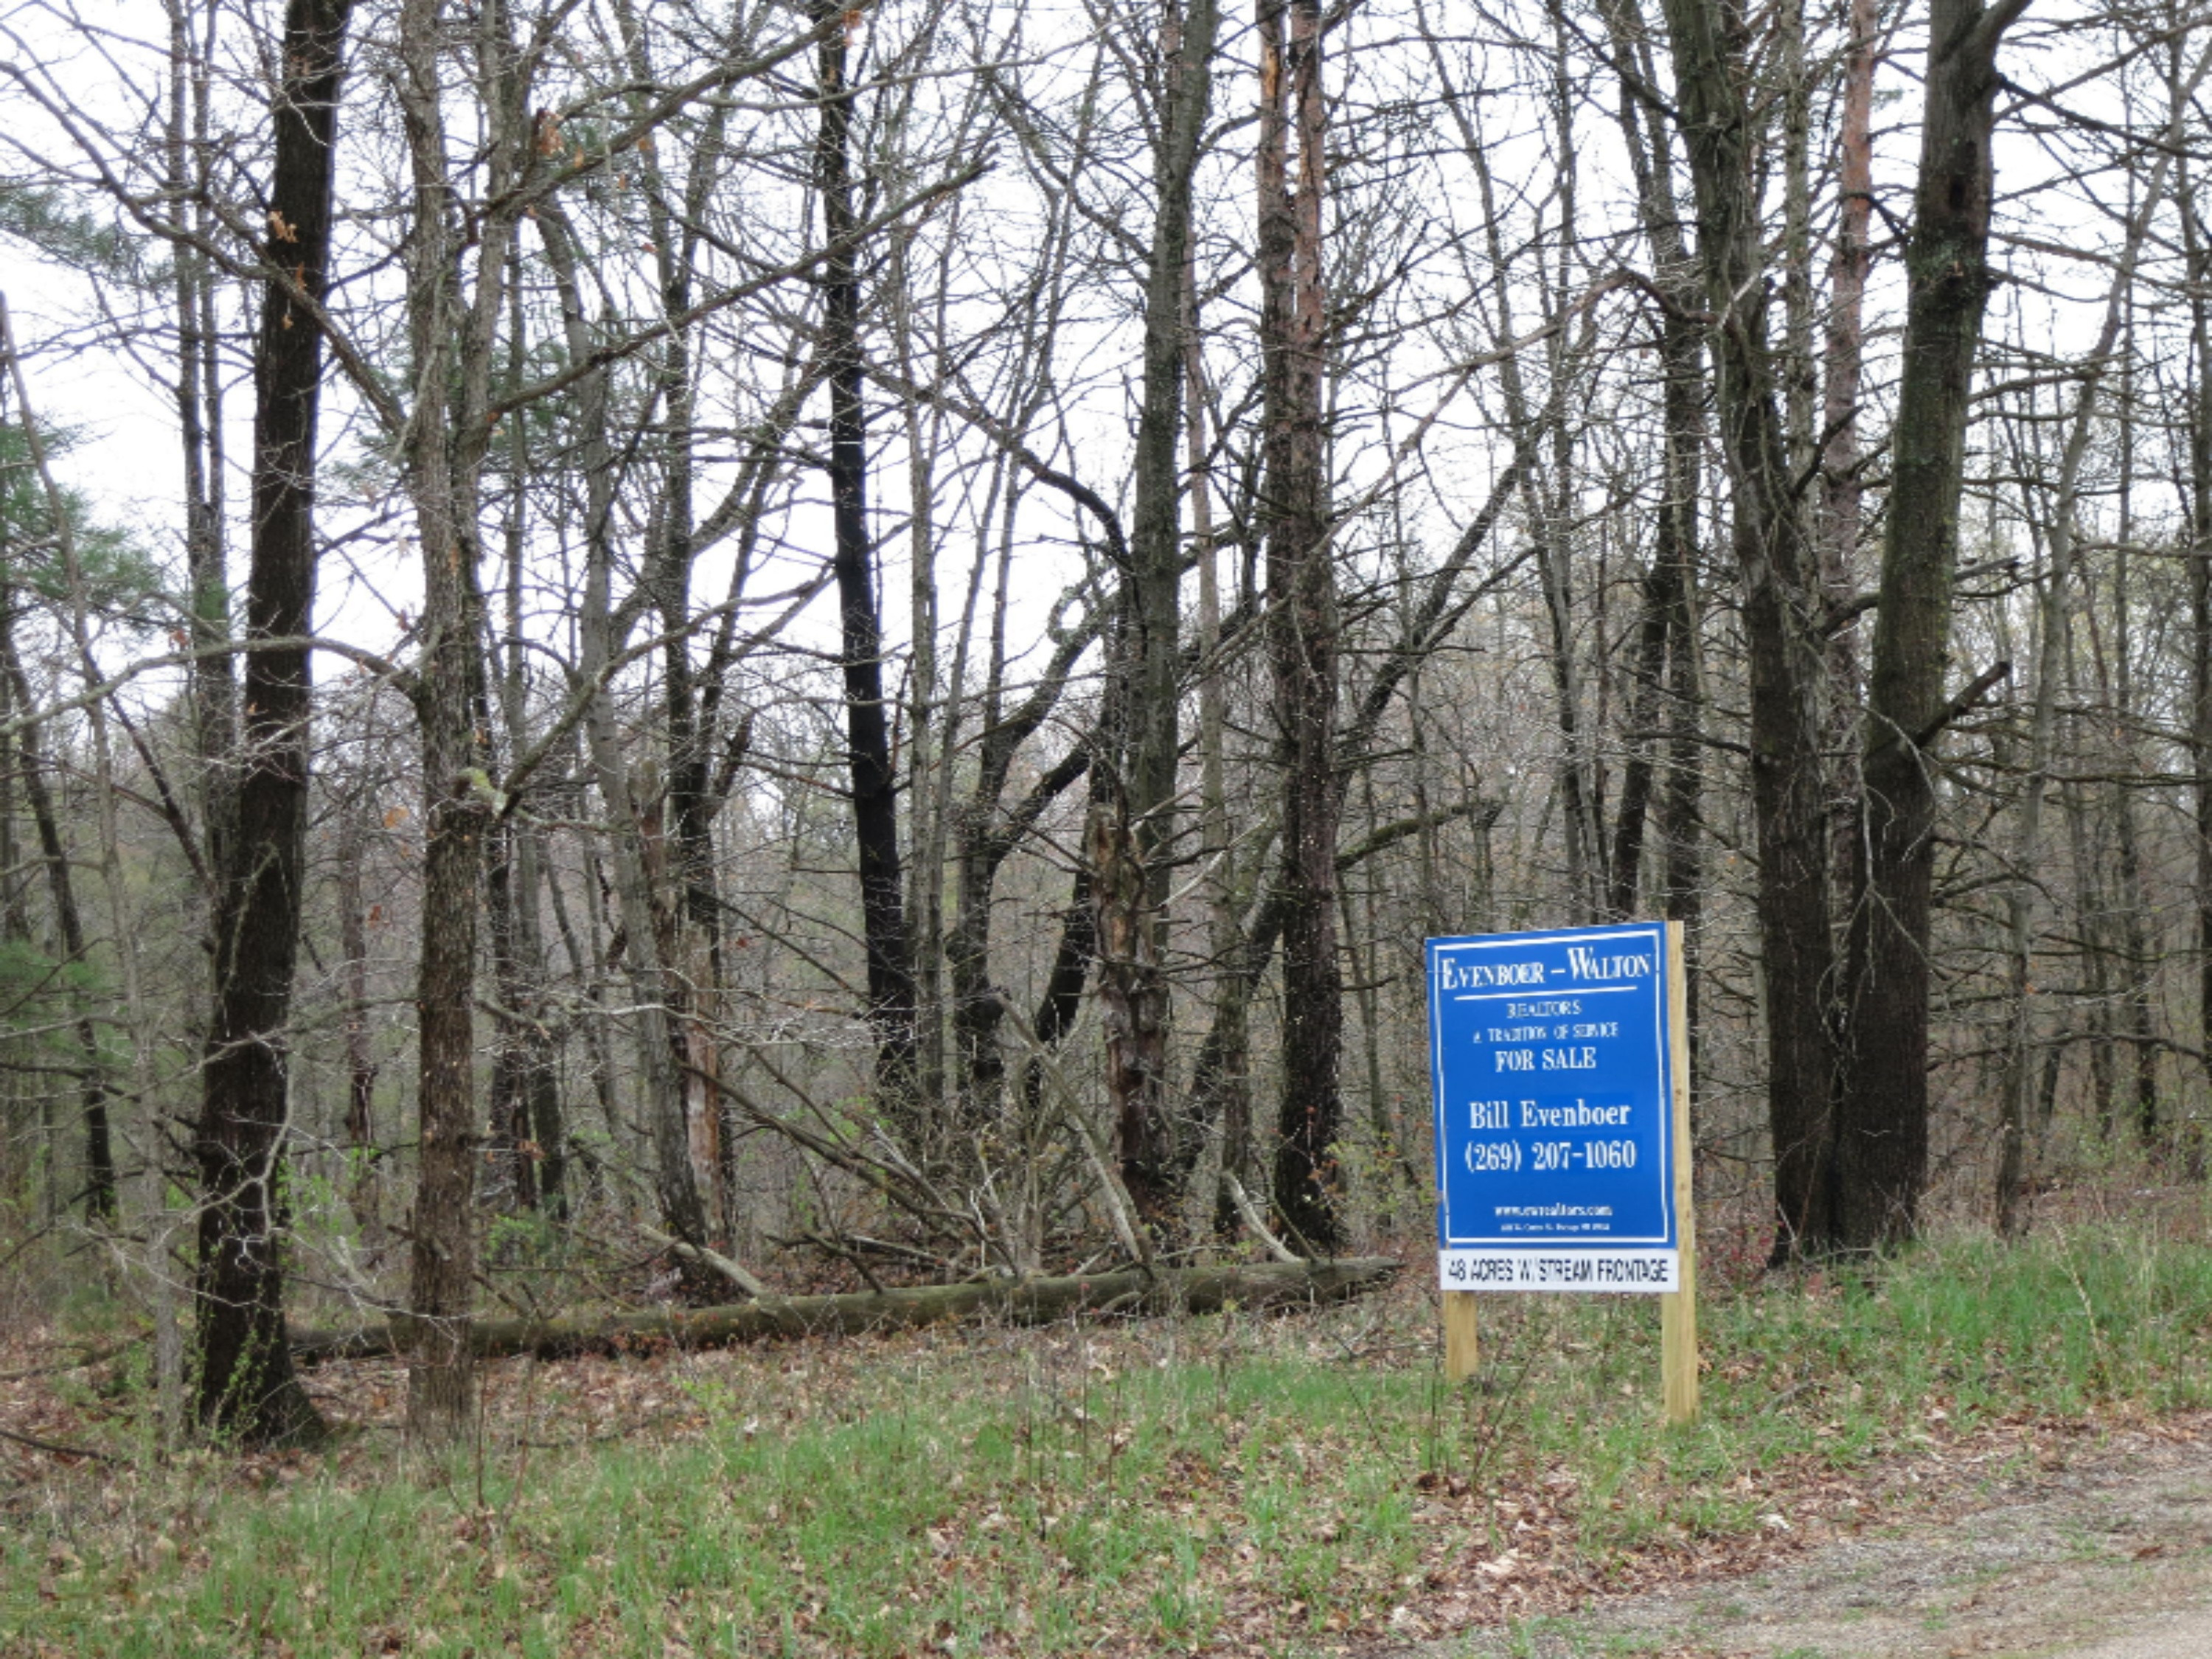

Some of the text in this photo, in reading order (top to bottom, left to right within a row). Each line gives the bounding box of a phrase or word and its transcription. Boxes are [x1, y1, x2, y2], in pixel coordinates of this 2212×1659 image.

[1506, 1000, 1582, 1018] REALTORS
[1487, 1026, 1547, 1042] TRADITION
[1554, 1025, 1568, 1040] OF
[1573, 1022, 1619, 1038] SERVICE
[1495, 1046, 1597, 1072] FOR SALE
[1469, 1099, 1632, 1129] Bill Evenboer
[1464, 1139, 1637, 1173] (269) 207-1060
[1448, 1258, 1467, 1281] 48
[1470, 1258, 1513, 1281] ACRES
[1598, 1258, 1669, 1281] FRONTAGE
